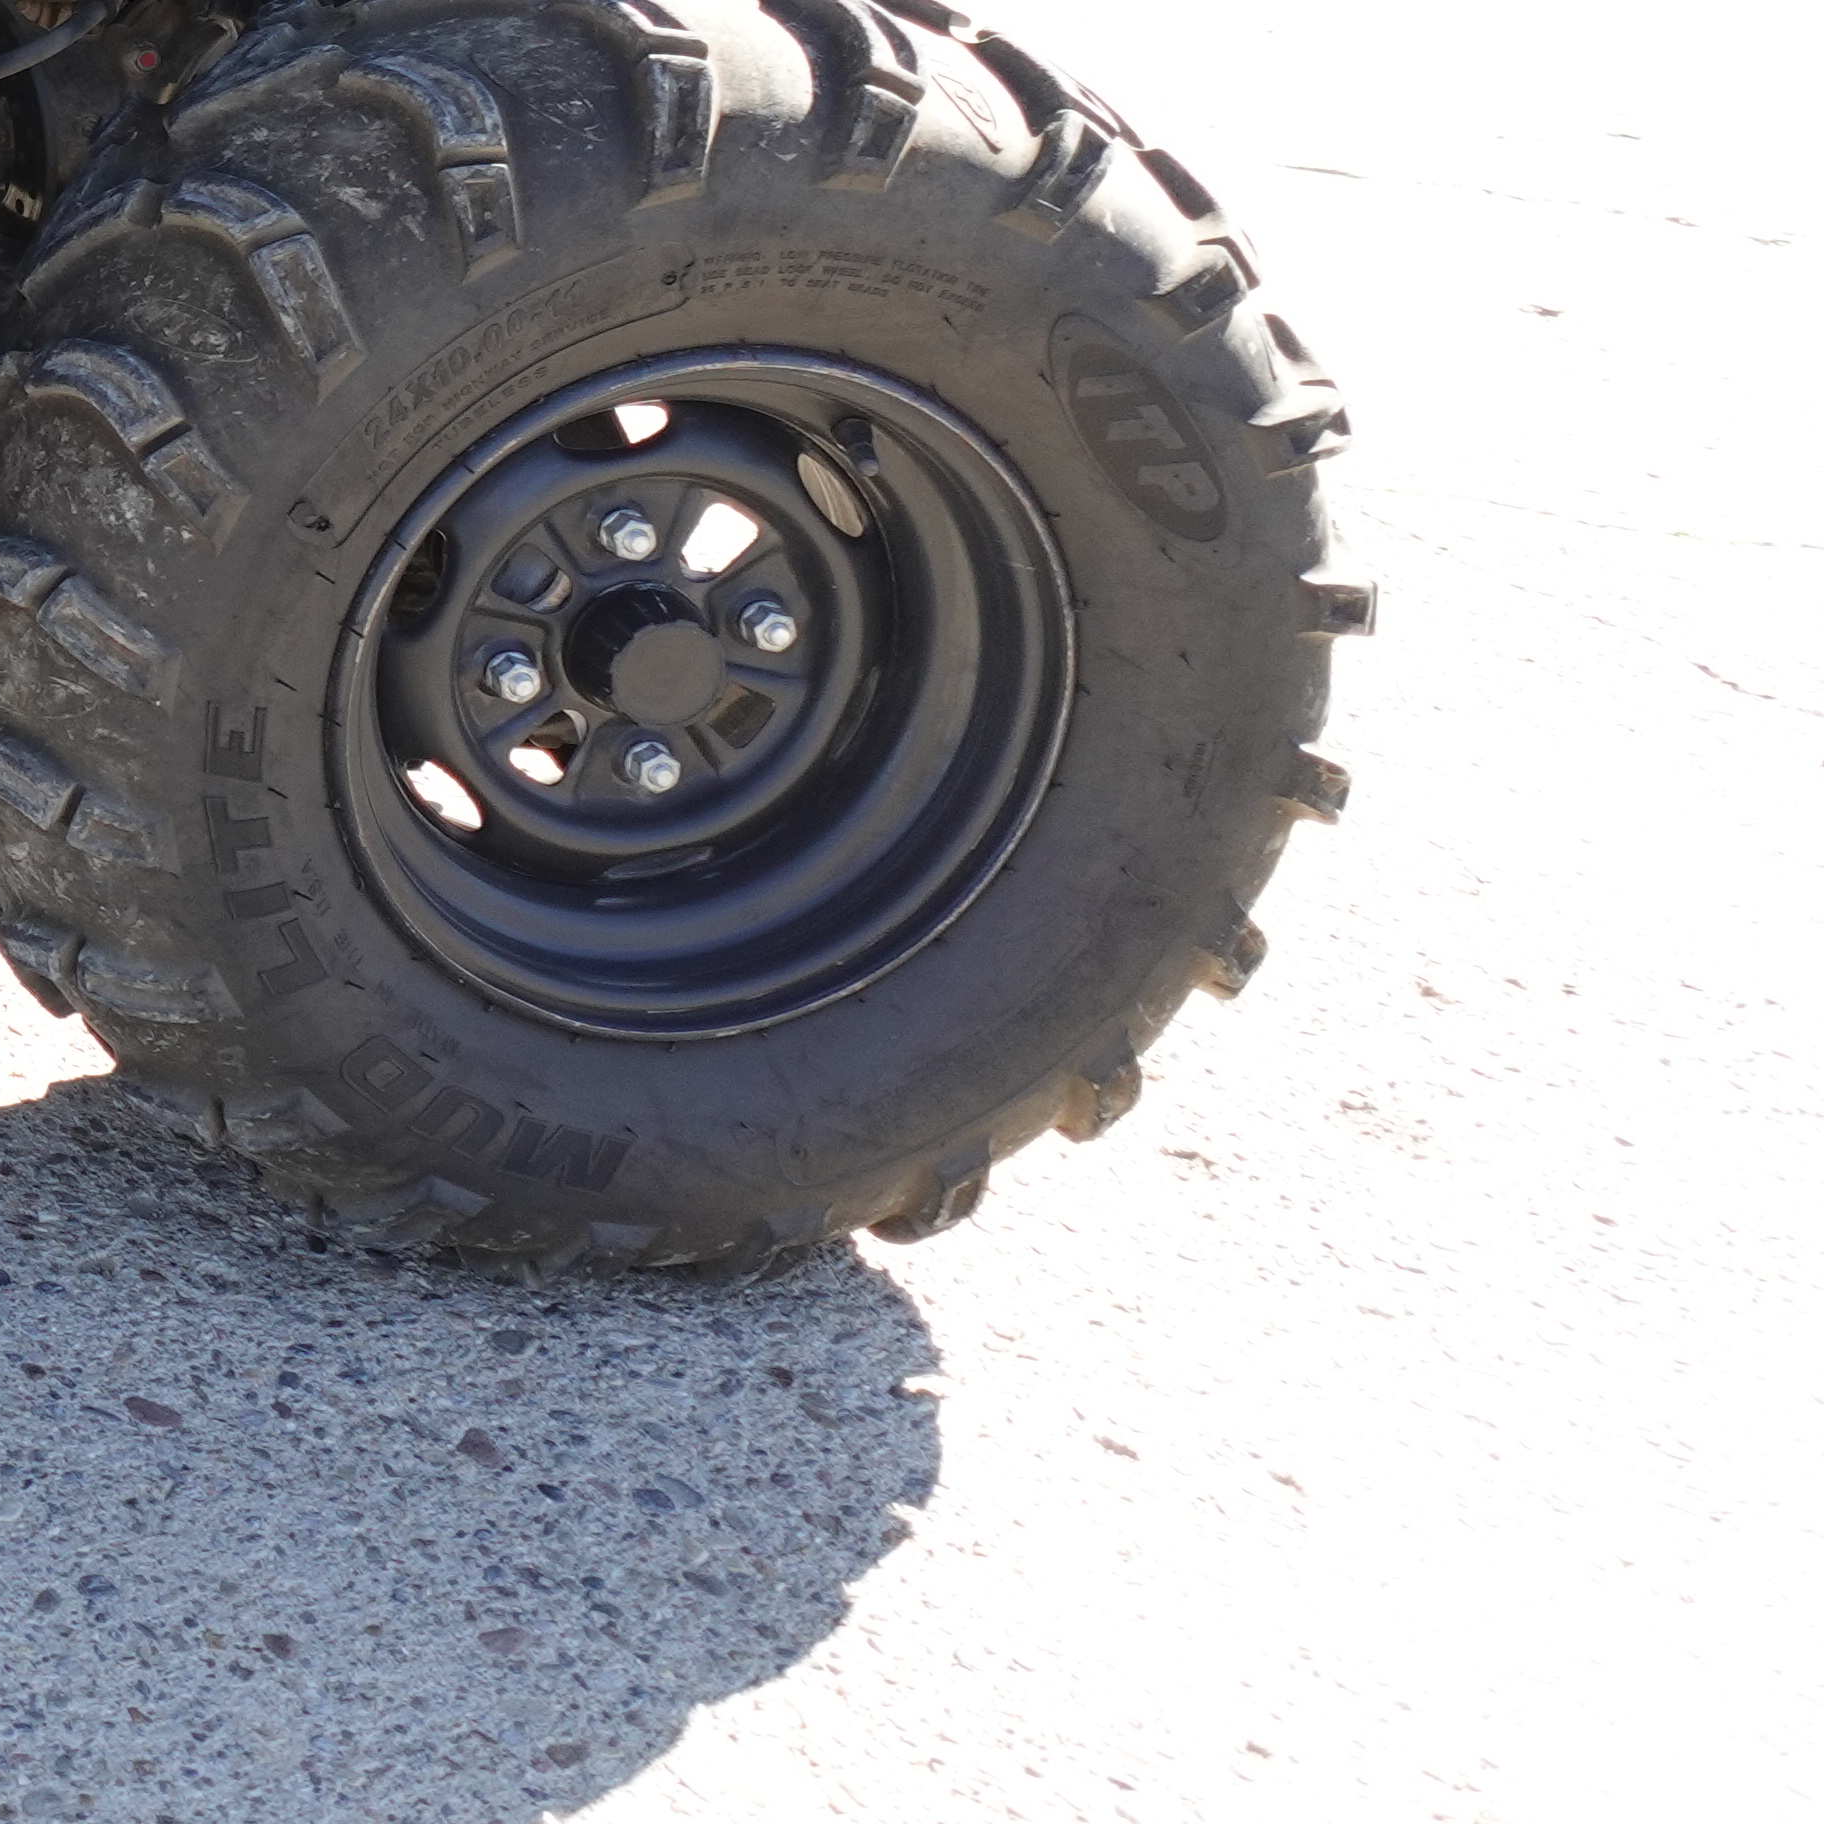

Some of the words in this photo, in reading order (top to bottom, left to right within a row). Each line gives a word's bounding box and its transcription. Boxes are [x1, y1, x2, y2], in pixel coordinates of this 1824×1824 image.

[429, 365, 549, 450] TUBELESS
[1074, 372, 1220, 513] ITP
[204, 699, 329, 997] LITE
[341, 1034, 637, 1194] MUD
